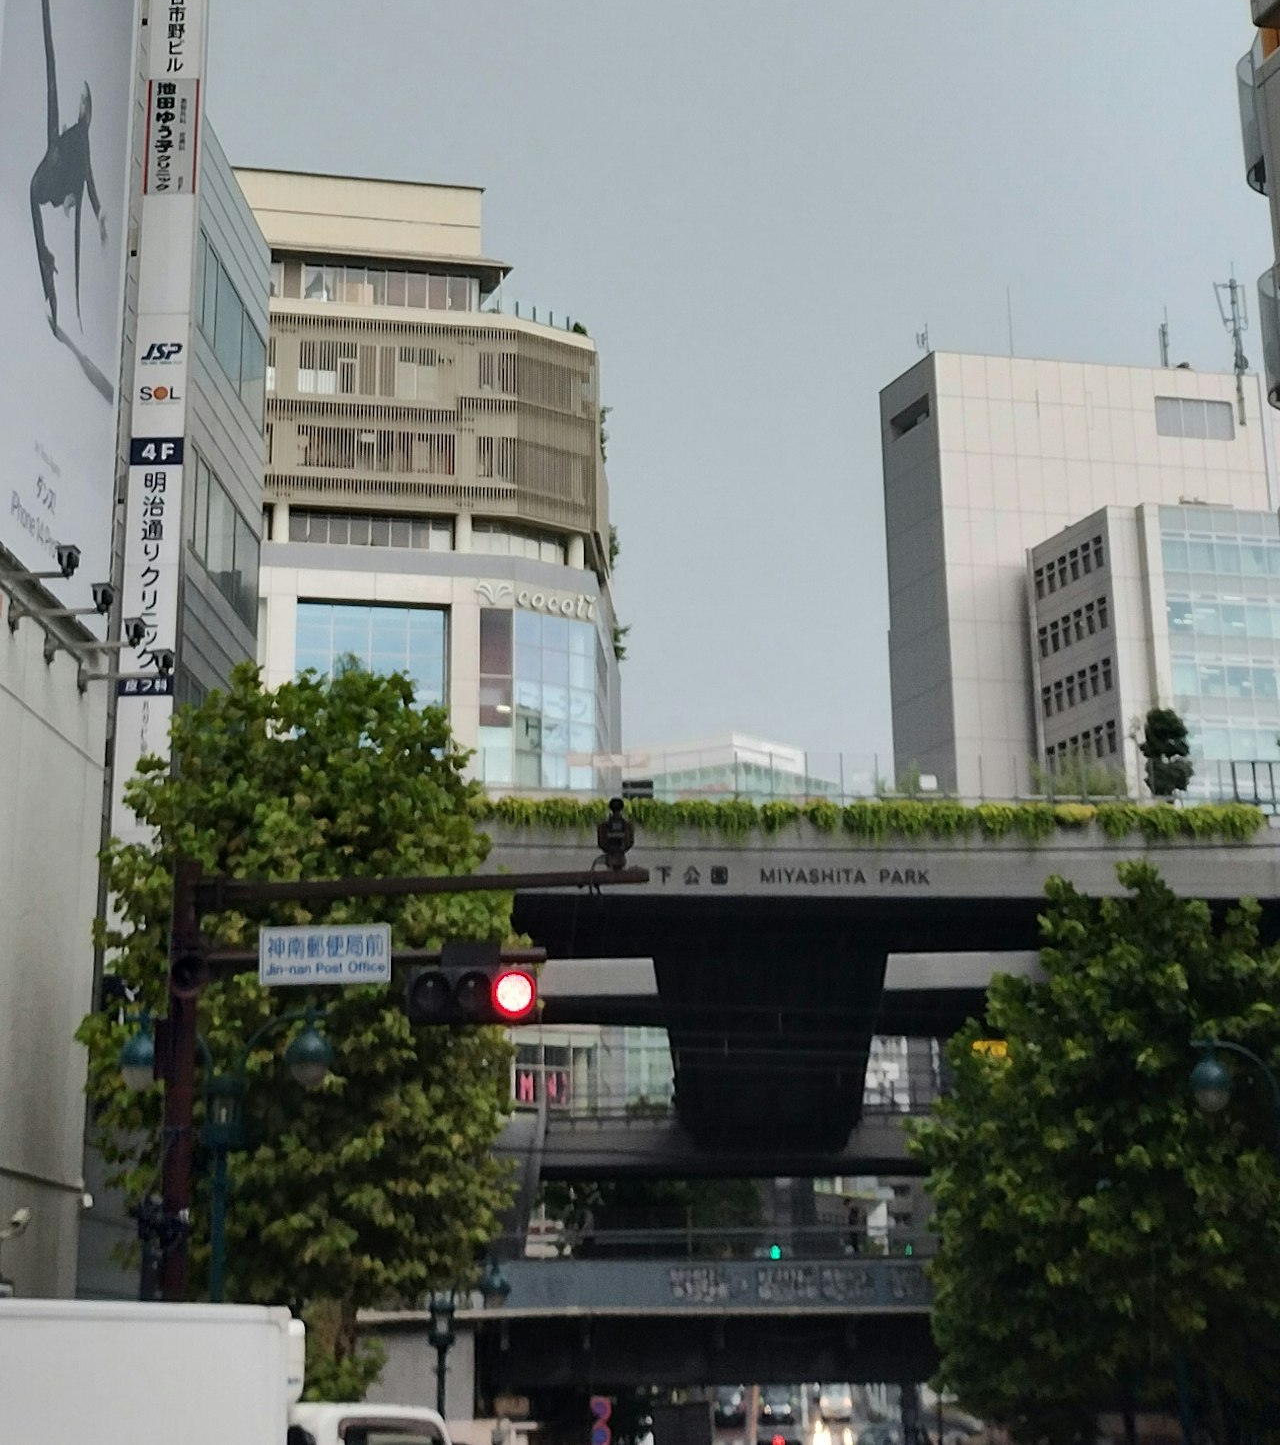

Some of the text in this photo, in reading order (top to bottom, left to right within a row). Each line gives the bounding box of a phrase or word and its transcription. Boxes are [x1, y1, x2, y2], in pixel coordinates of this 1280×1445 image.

[516, 589, 597, 620] cocoti
[760, 867, 867, 886] MIYASHITA
[879, 867, 930, 886] PARK
[267, 934, 384, 959] 神南郵便局前
[316, 962, 343, 974] Post
[348, 960, 387, 974] Office
